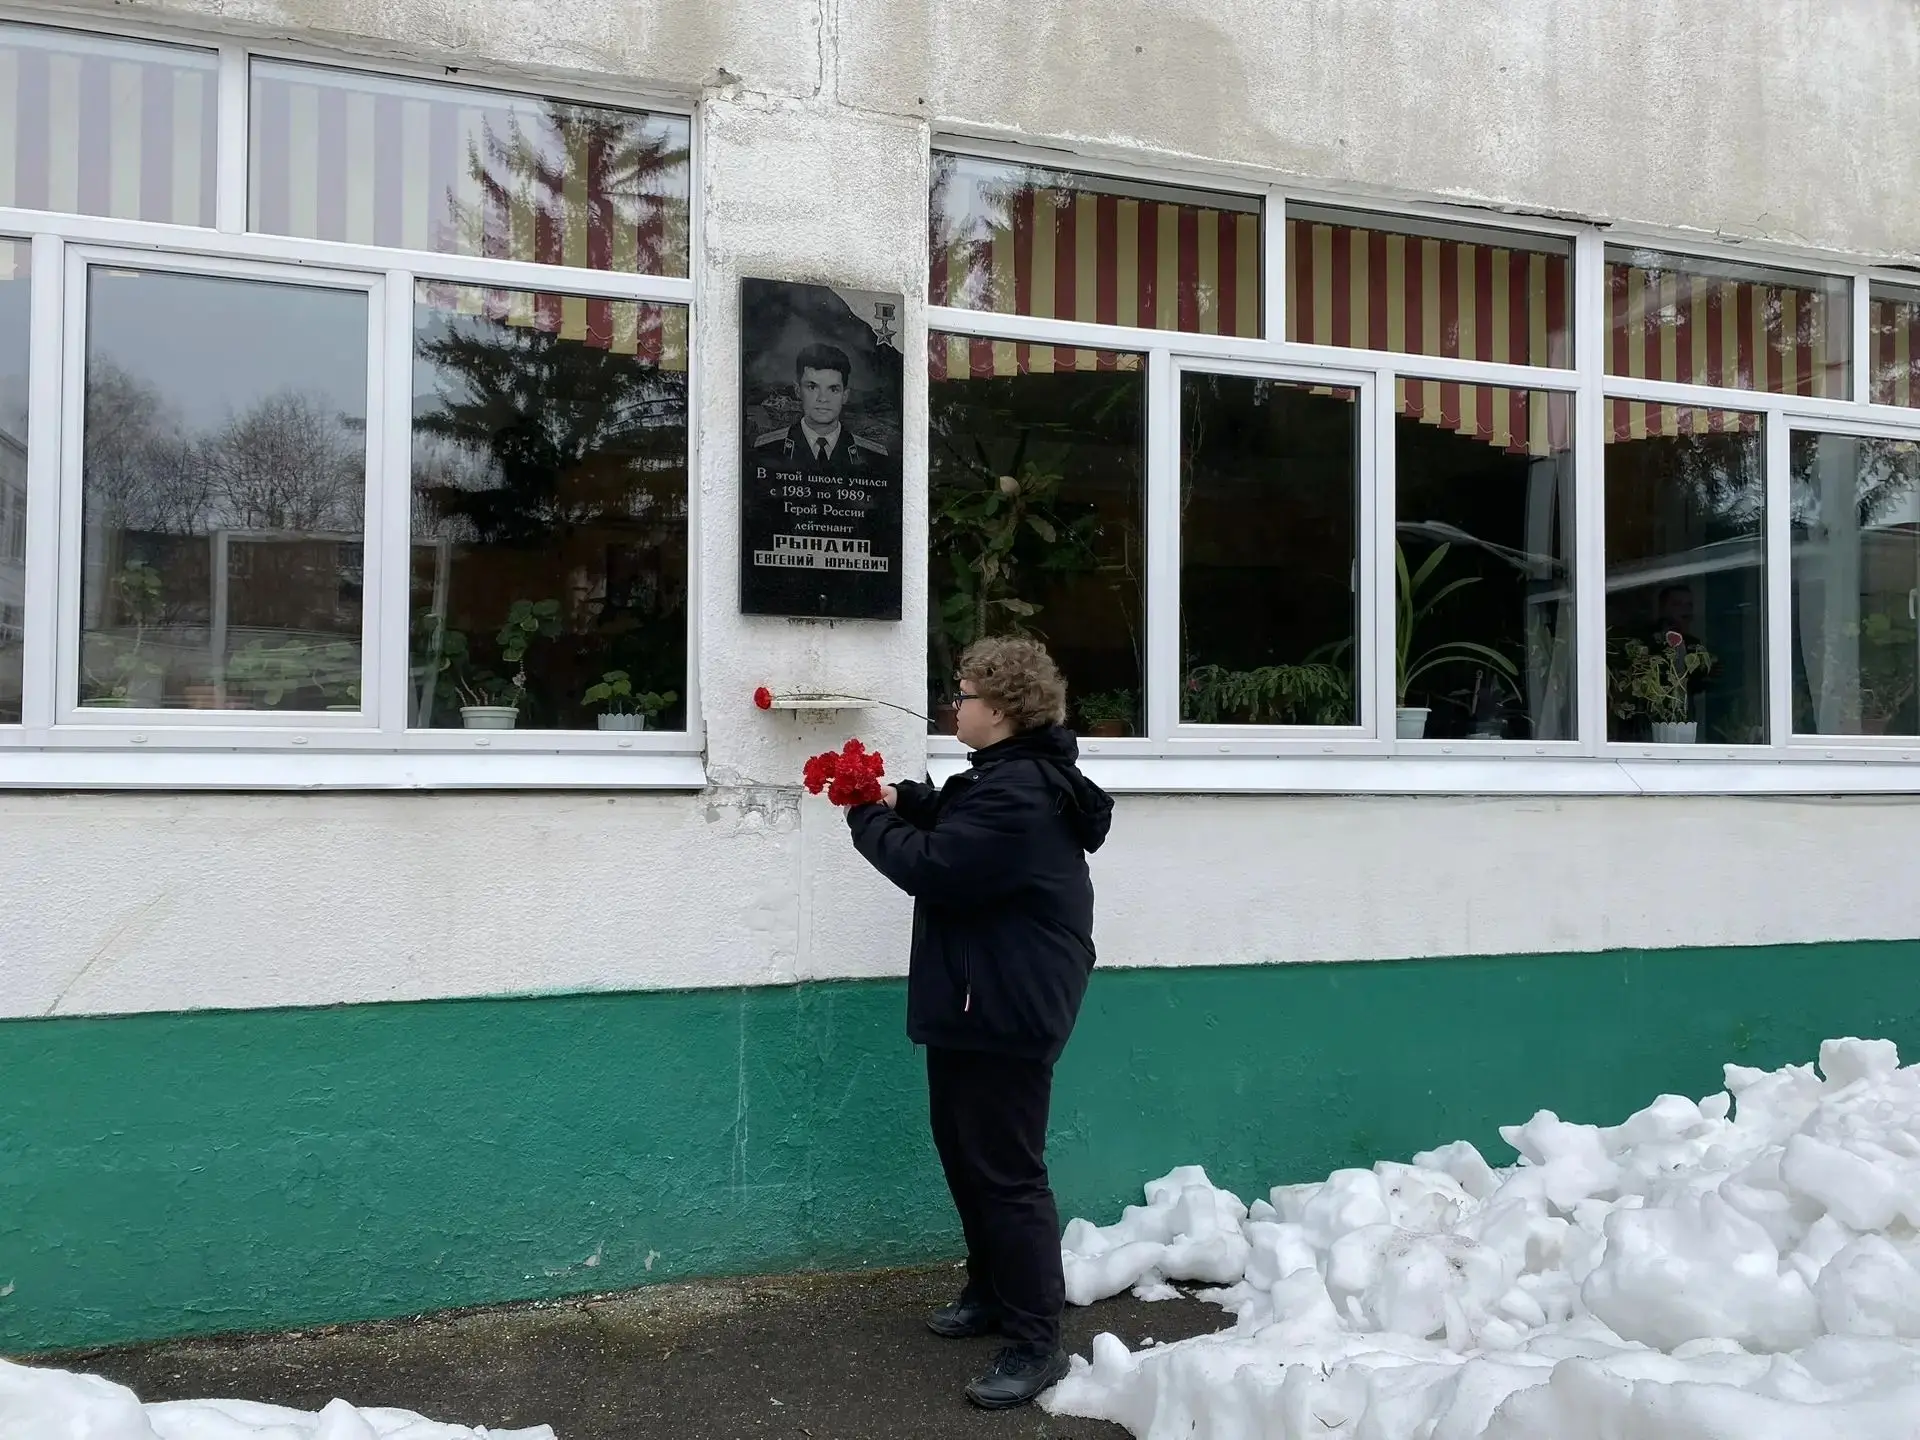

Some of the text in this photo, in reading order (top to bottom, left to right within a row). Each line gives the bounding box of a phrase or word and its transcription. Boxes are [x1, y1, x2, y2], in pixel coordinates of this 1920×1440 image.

[757, 467, 887, 487] В этой школе учился
[770, 488, 776, 496] с
[782, 486, 811, 497] 1983
[817, 491, 830, 499] по
[784, 502, 865, 517] Герой России
[794, 521, 854, 533] лейтенант
[775, 537, 869, 553] РЫНДИН
[755, 553, 887, 570] ЕВГЕНИЙ ЮРЬЕВИЧ
